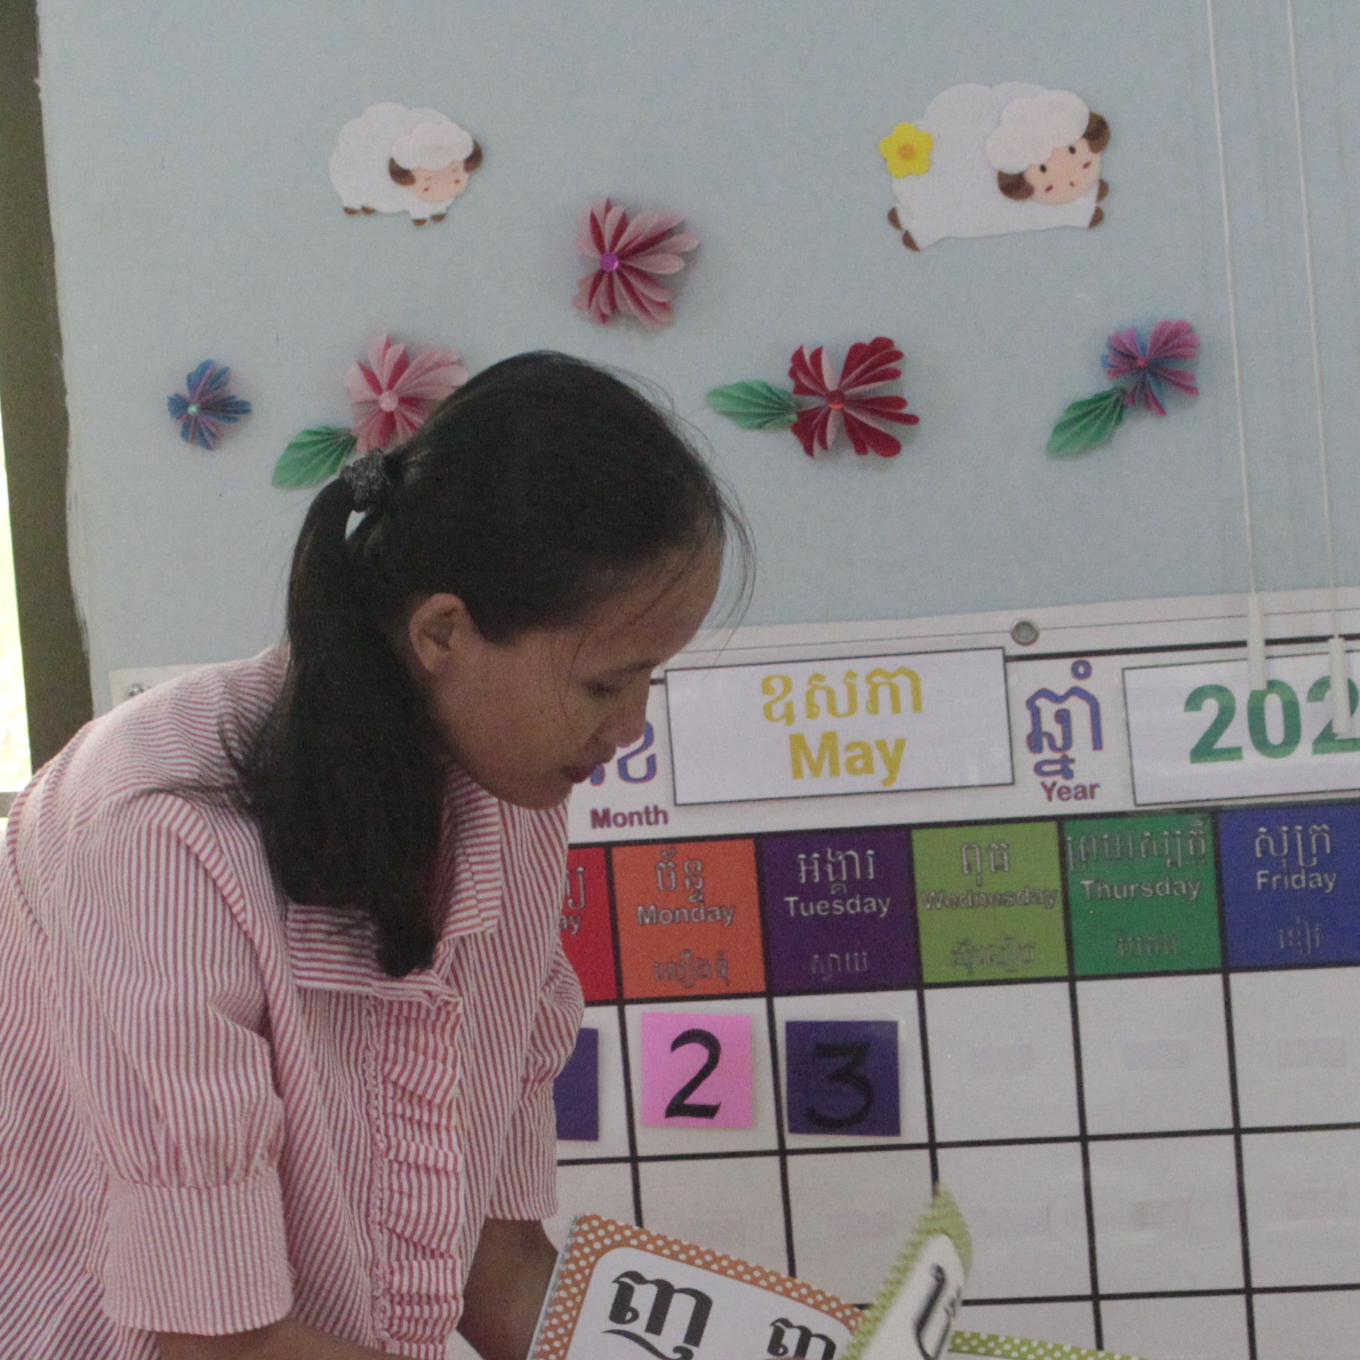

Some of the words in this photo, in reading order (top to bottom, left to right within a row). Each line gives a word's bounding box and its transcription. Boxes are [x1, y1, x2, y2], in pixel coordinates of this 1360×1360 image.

[788, 731, 907, 787] May
[1041, 781, 1100, 802] Year
[590, 805, 668, 829] Month
[1080, 877, 1201, 901] Thursday
[1256, 869, 1337, 893] Friday
[784, 895, 891, 917] Tuesday
[921, 887, 1059, 910] Wednesday
[637, 904, 735, 927] Monday
[663, 1028, 724, 1119] 2
[804, 1039, 875, 1130] 3
